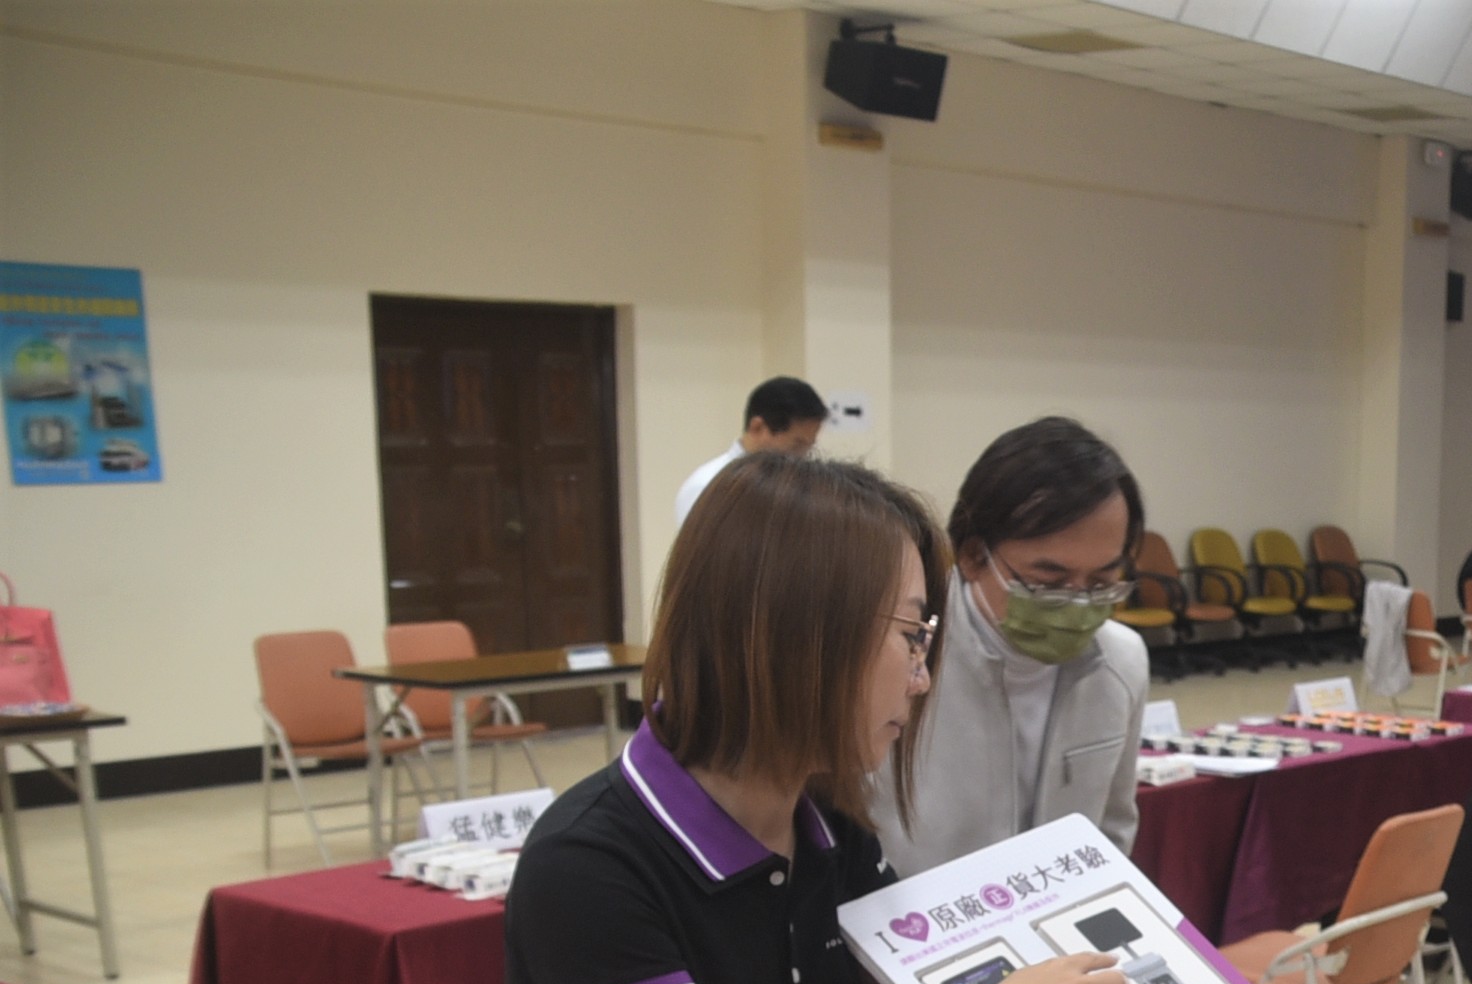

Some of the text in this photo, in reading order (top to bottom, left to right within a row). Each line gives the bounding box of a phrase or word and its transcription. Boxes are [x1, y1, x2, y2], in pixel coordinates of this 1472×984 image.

[927, 844, 1111, 933] 原廠正貨大考驗
